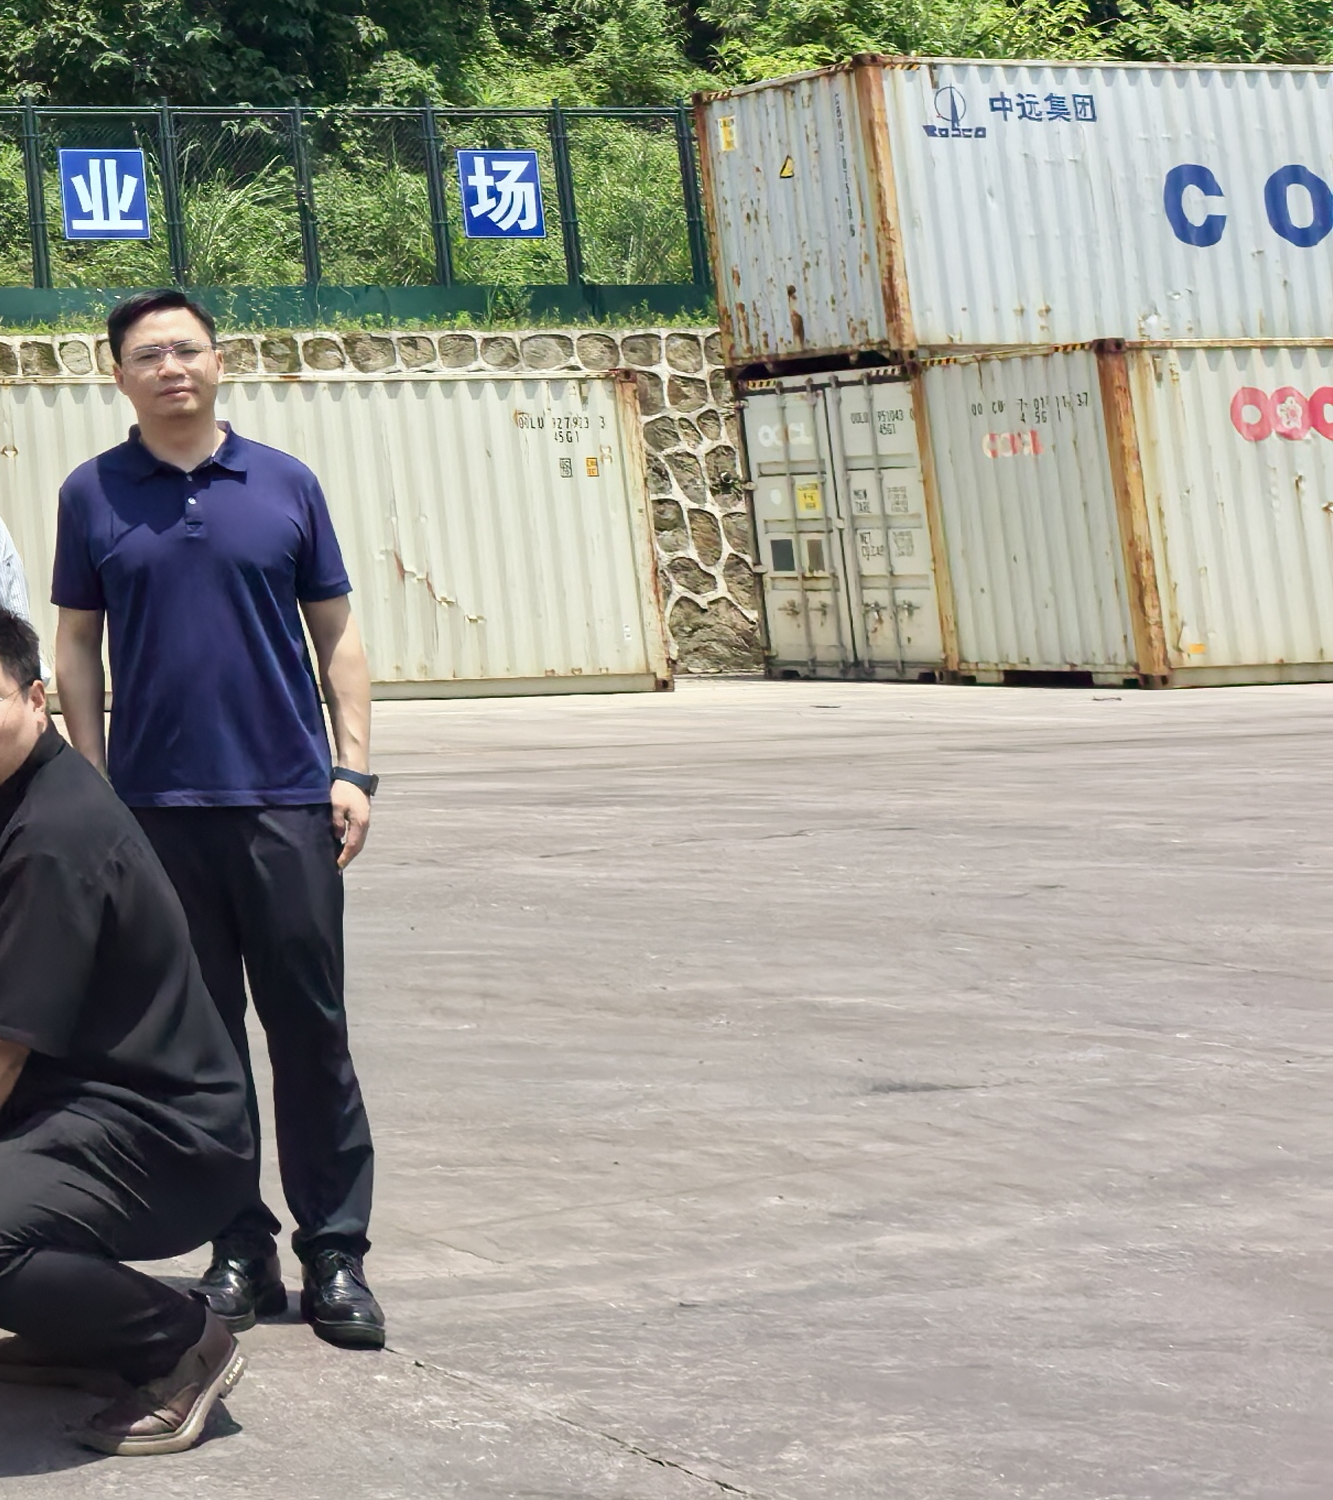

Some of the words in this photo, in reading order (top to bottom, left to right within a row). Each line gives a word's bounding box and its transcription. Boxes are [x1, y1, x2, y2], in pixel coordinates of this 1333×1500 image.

[988, 90, 1097, 122] 中远集团
[70, 158, 148, 231] 业
[467, 156, 539, 231] 场
